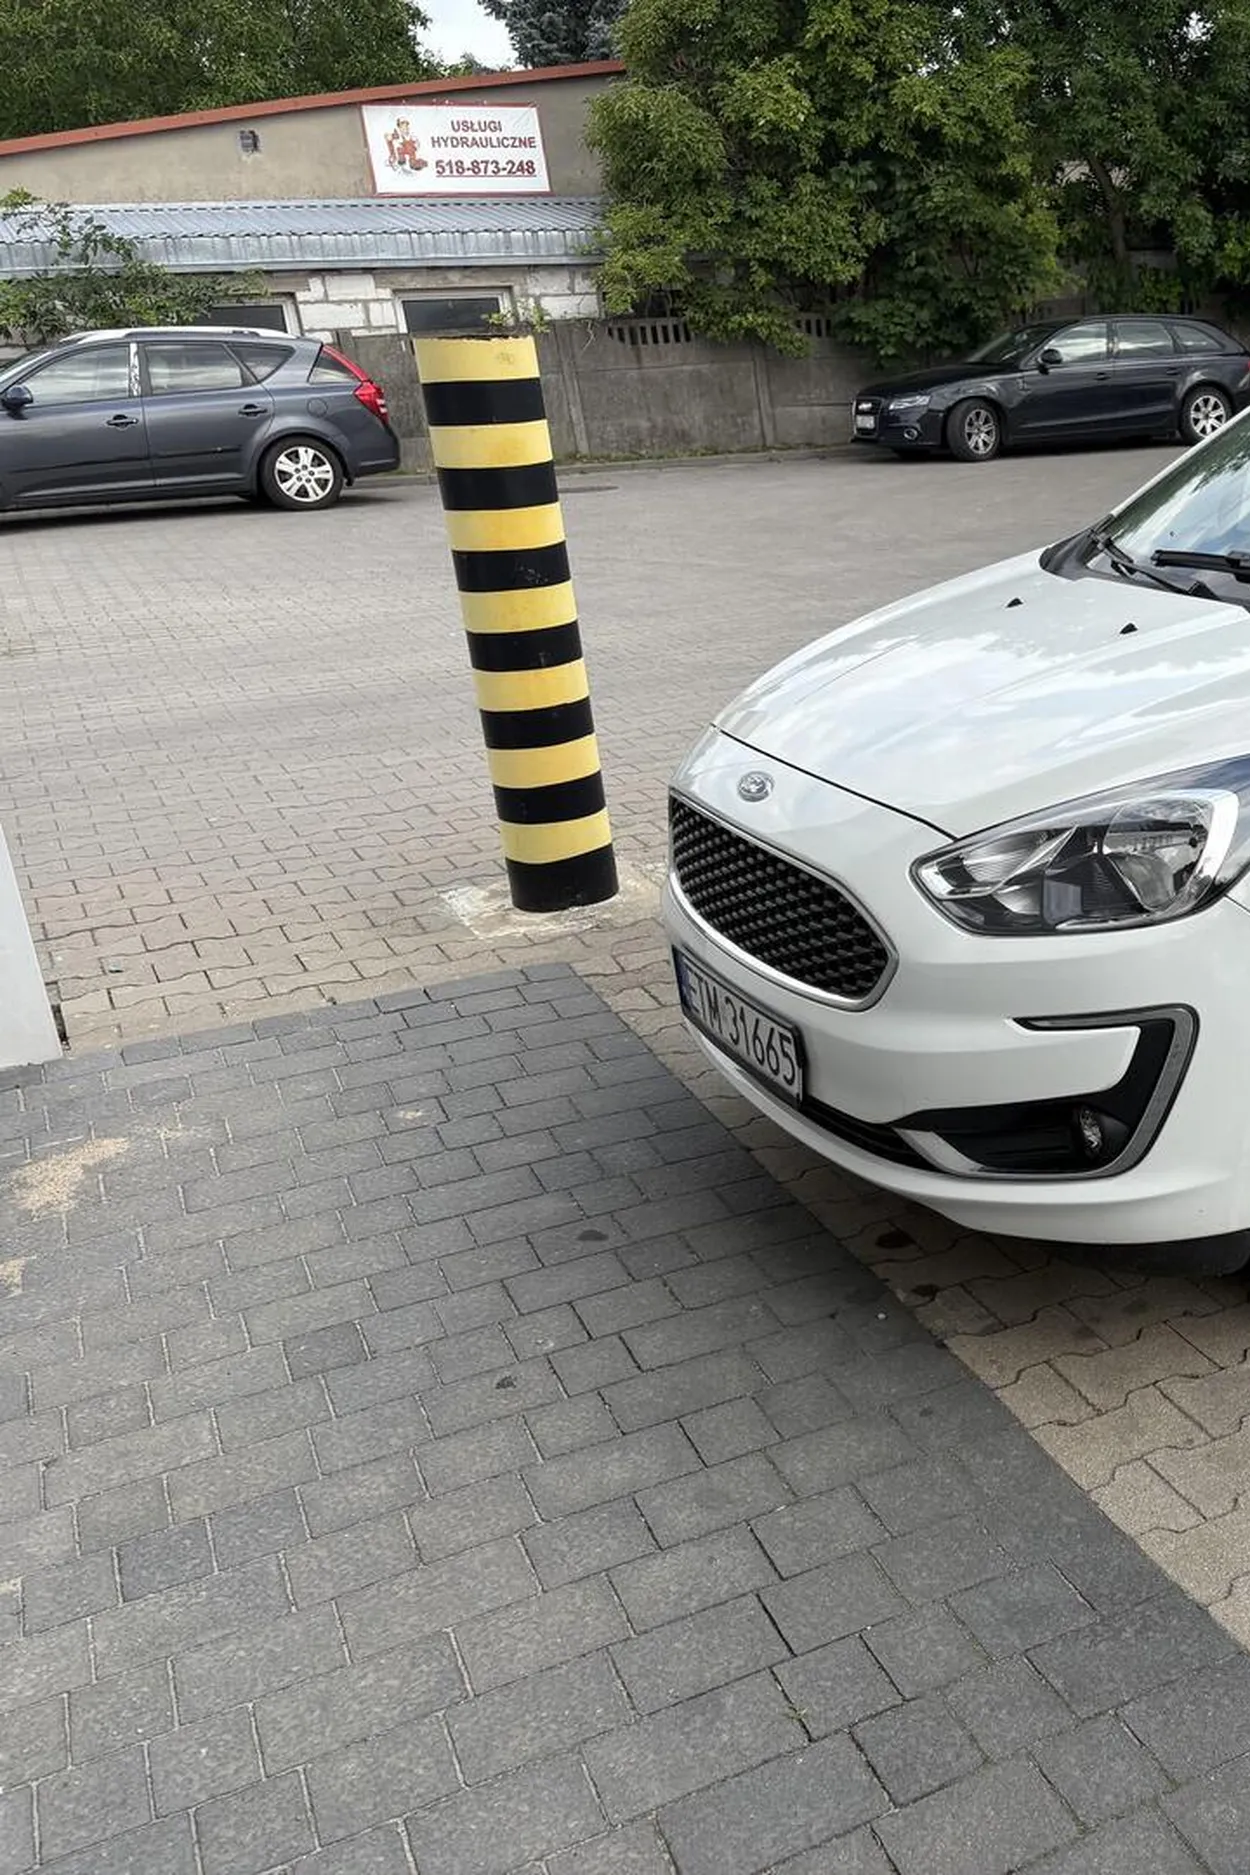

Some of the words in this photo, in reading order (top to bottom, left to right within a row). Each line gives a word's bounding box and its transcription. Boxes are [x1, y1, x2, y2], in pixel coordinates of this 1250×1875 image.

[450, 120, 503, 133] USŁUGI
[431, 136, 537, 149] HYDRAULICZNE
[435, 159, 537, 176] 518-873-248
[725, 995, 797, 1087] 31665
